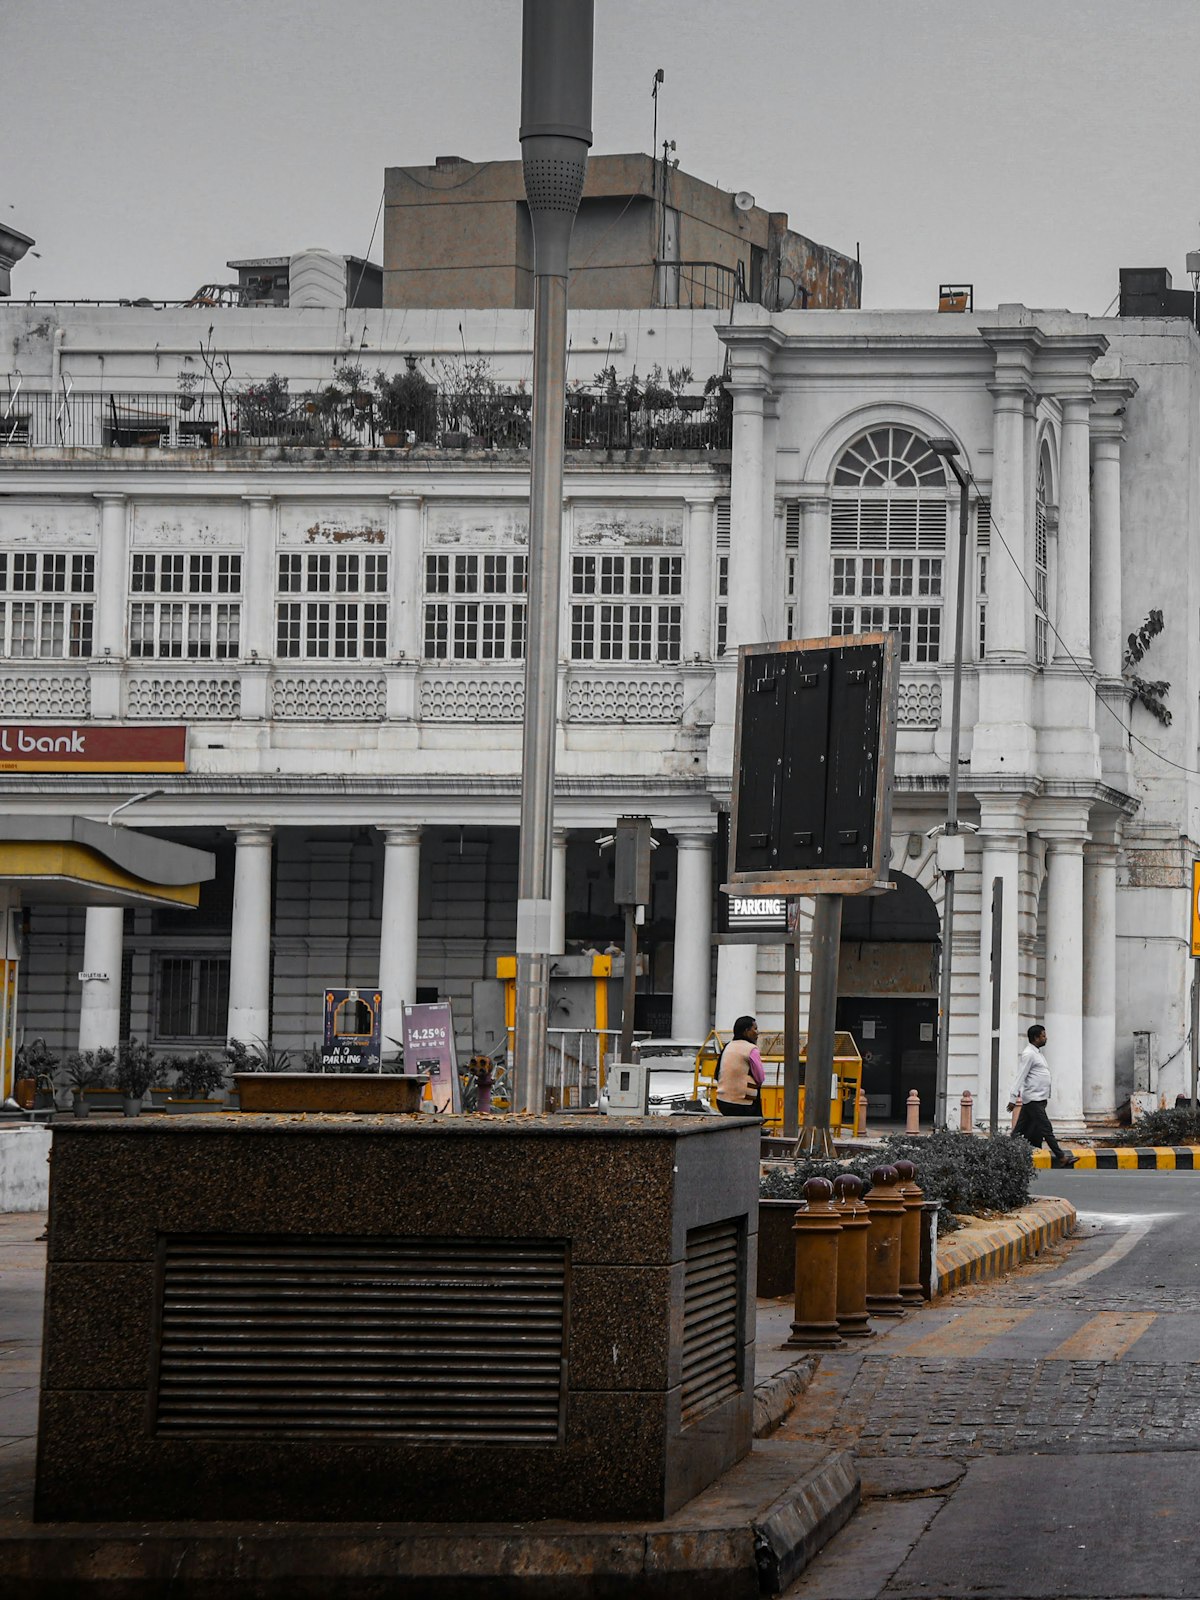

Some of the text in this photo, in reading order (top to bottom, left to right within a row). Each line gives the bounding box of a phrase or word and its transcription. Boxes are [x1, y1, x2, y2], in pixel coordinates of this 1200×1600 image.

[17, 729, 86, 753] bank
[734, 899, 781, 915] PARKING
[412, 1027, 446, 1040] 4.25%
[322, 1055, 361, 1064] PARKING
